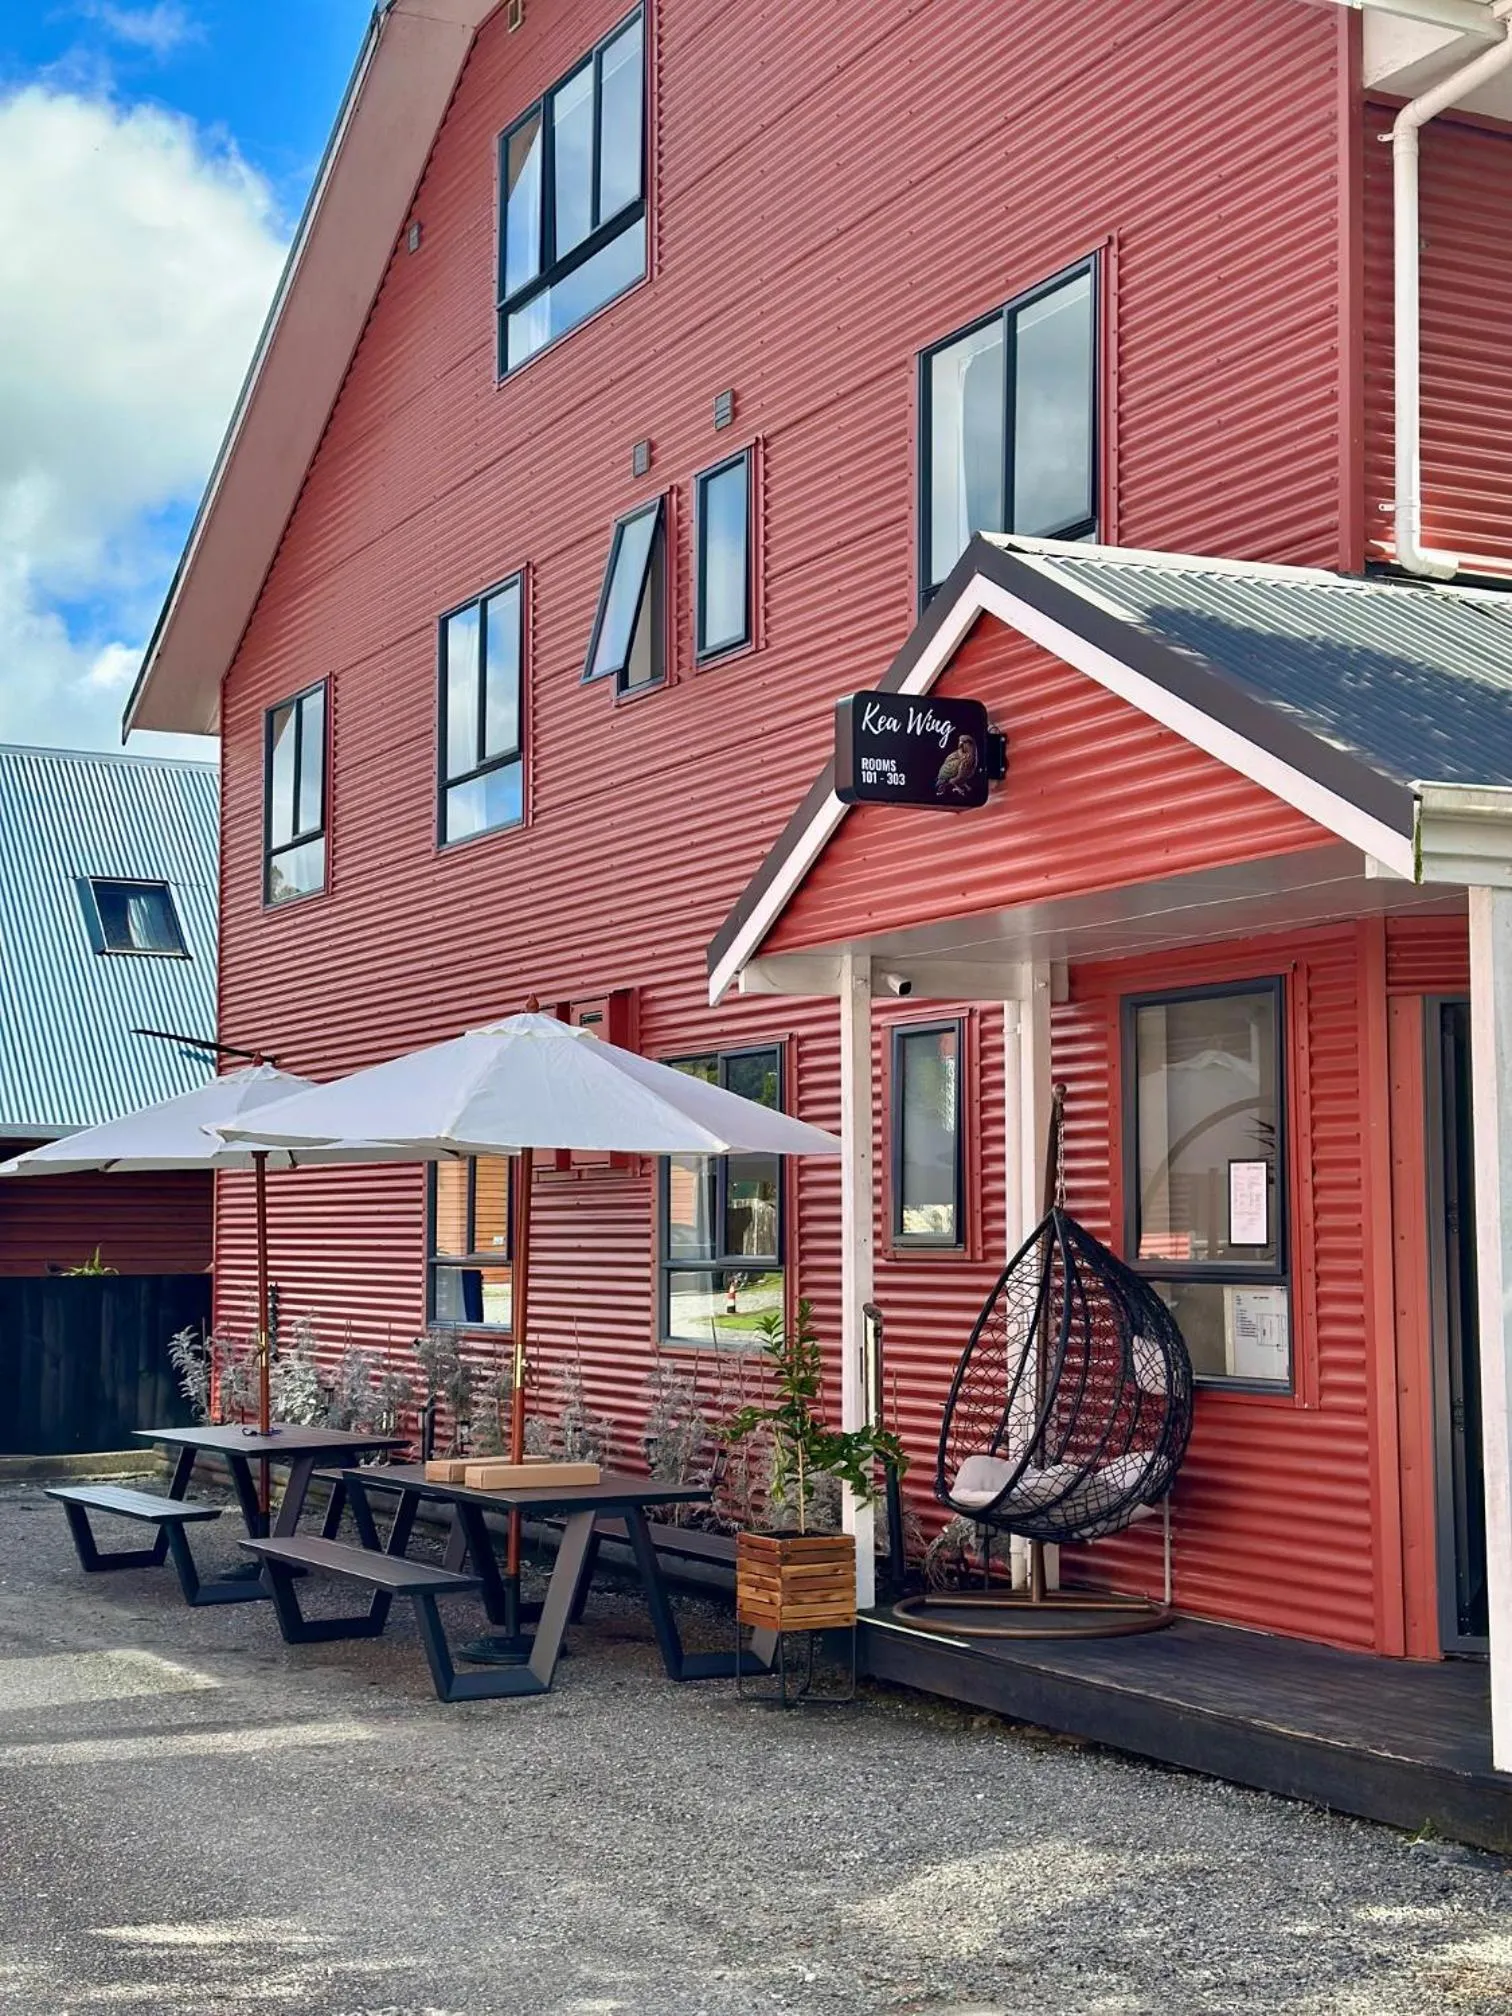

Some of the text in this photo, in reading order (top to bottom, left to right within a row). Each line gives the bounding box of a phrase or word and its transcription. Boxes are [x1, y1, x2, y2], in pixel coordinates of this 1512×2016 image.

[862, 702, 956, 748] Kea Wing
[861, 757, 896, 771] ROOMS
[862, 771, 877, 784] 101
[887, 773, 906, 786] 303
